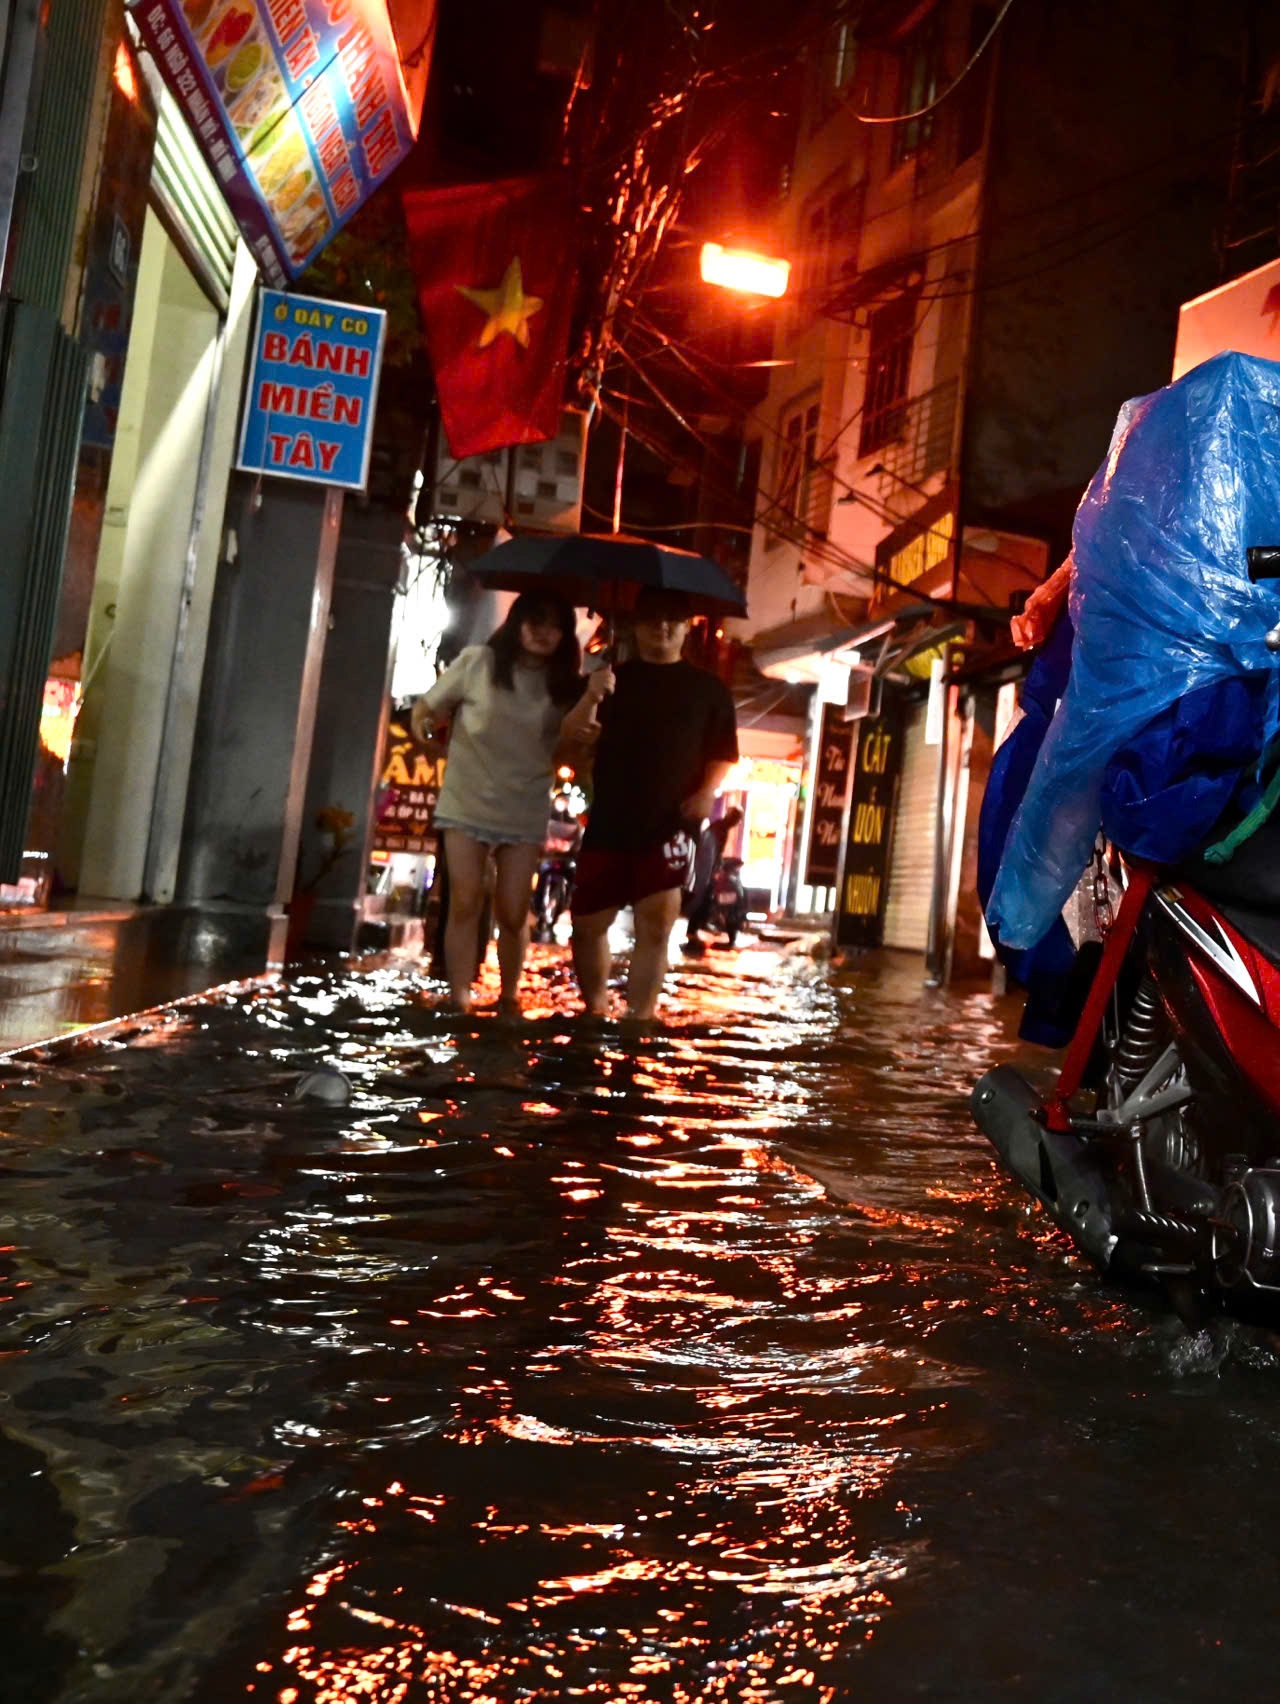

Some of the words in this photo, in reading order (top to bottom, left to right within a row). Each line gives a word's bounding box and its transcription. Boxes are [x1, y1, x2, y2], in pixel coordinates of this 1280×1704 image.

[262, 330, 371, 378] BÁNH
[258, 380, 362, 426] MIỀN
[269, 430, 342, 472] TÂY
